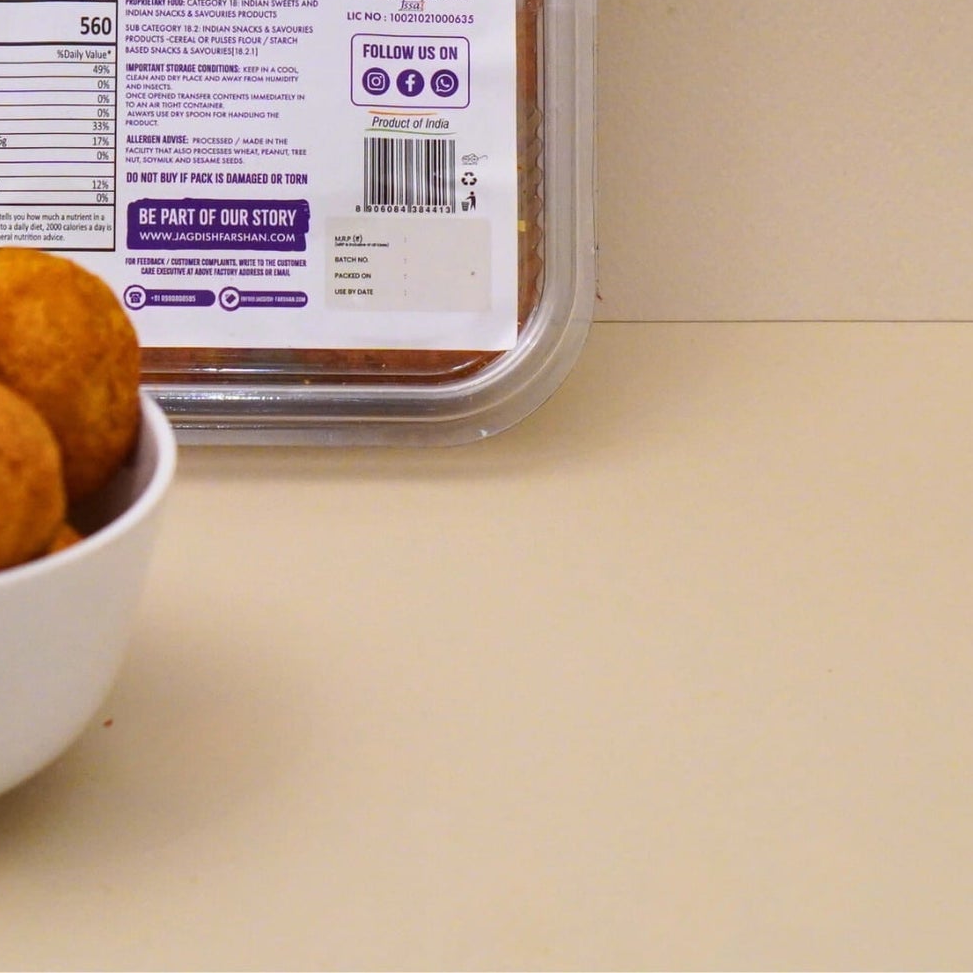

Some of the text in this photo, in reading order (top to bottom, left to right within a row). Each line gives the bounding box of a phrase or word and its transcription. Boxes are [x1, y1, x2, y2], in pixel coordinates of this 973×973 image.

[187, 0, 227, 7] CATEGORY
[302, 0, 318, 8] AND
[347, 12, 474, 24] LIC NO 10021021000635
[80, 17, 111, 35] 560
[272, 26, 314, 34] SAVOURIES
[126, 35, 164, 43] PRODUCTS
[198, 36, 209, 44] OR
[57, 50, 83, 60] %Daily
[183, 47, 188, 55] &
[363, 44, 458, 60] FOLLOW US ON
[93, 66, 110, 74] 49%
[126, 64, 164, 72] IMPORTANT
[166, 64, 196, 73] STORAGE
[198, 65, 240, 73] CONDITIONS:
[98, 80, 110, 89] 0%
[98, 95, 109, 103] 0%
[97, 109, 109, 117] 0%
[93, 122, 109, 131] 33%
[372, 116, 449, 129] Product of India
[93, 138, 109, 146] 17%
[97, 151, 109, 160] 0%
[127, 172, 308, 185] DO NOT BUY IF PACK IS DAMAGED OR TORN
[92, 181, 108, 189] 12%
[96, 194, 108, 202] 0%
[139, 208, 297, 227] BE PART OF OUR STORY
[139, 232, 295, 242] WWW.JAGDISHFARSHAN.COM
